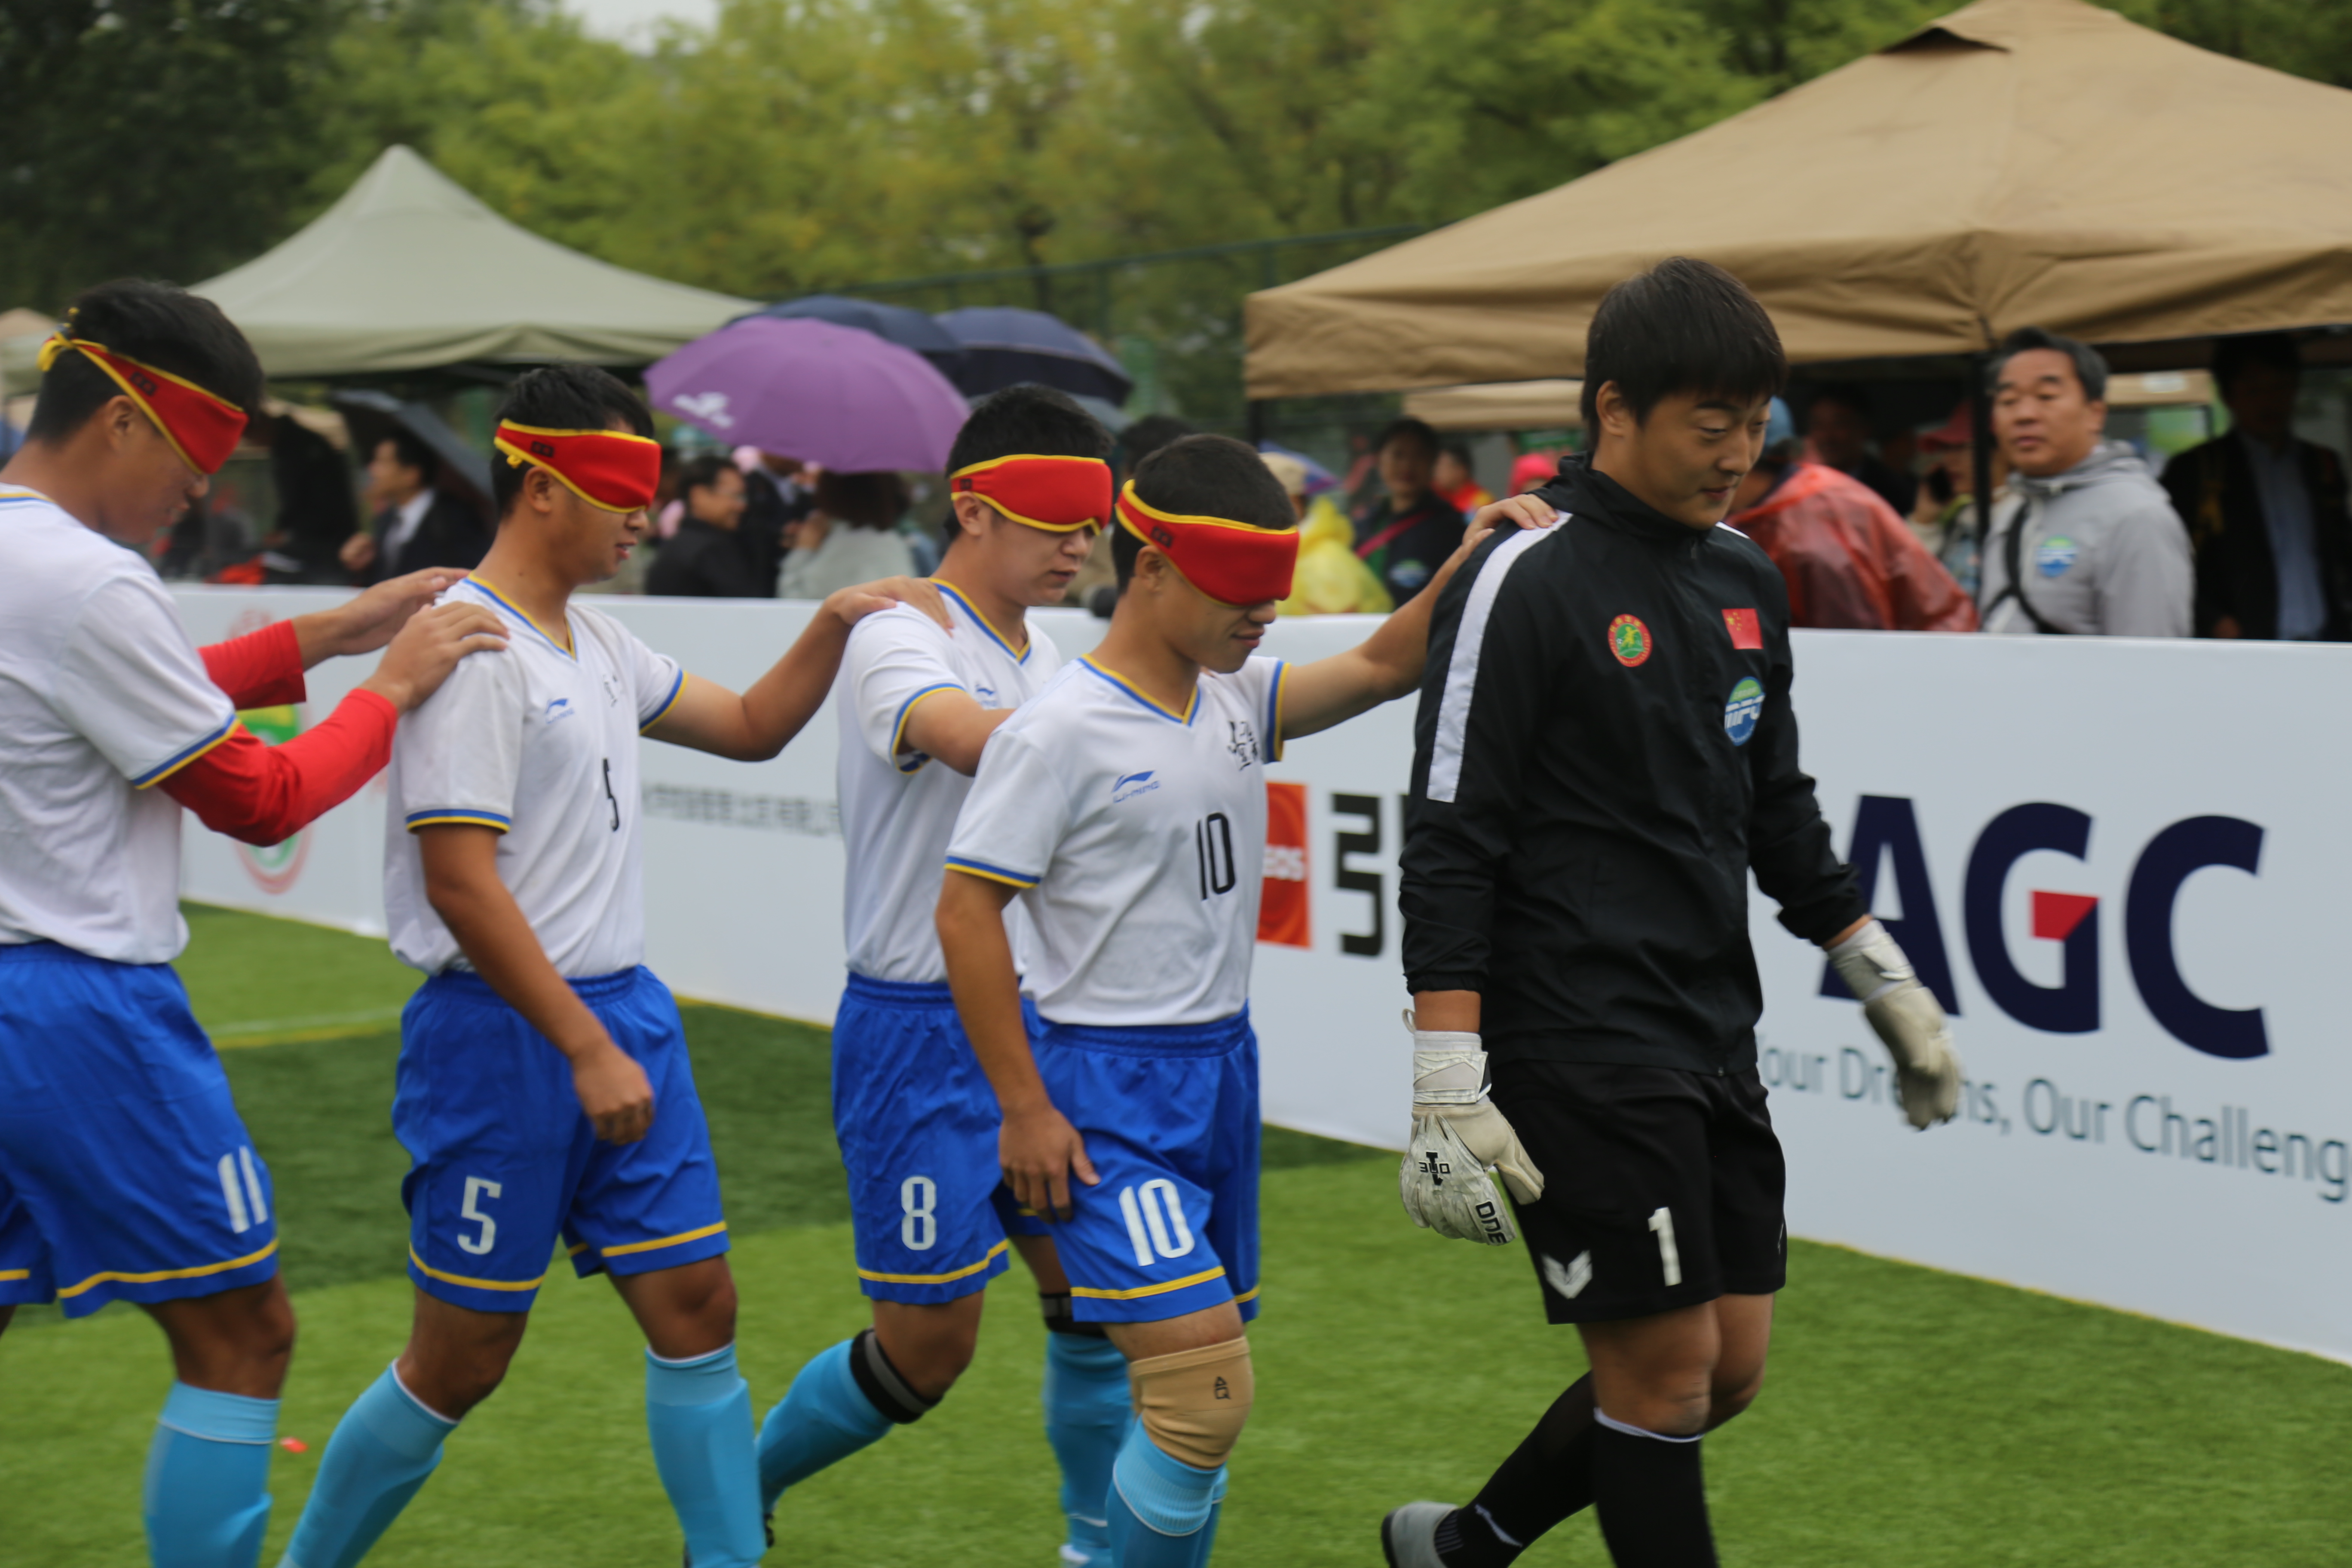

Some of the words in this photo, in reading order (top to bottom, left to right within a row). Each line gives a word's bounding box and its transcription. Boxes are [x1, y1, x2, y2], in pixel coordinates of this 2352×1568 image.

[1196, 812, 1236, 900] 10
[1818, 794, 2271, 1060] AGC
[1757, 1035, 1825, 1095] our
[1840, 1046, 2012, 1136] Drs,
[2023, 1078, 2112, 1144] Our
[2124, 1093, 2352, 1204] Challeng
[217, 1145, 268, 1234] 11
[457, 1175, 502, 1255] 5
[901, 1176, 937, 1250] 8
[1118, 1179, 1195, 1266] 10
[1476, 1201, 1507, 1243] ONE
[1648, 1207, 1681, 1286] 1
